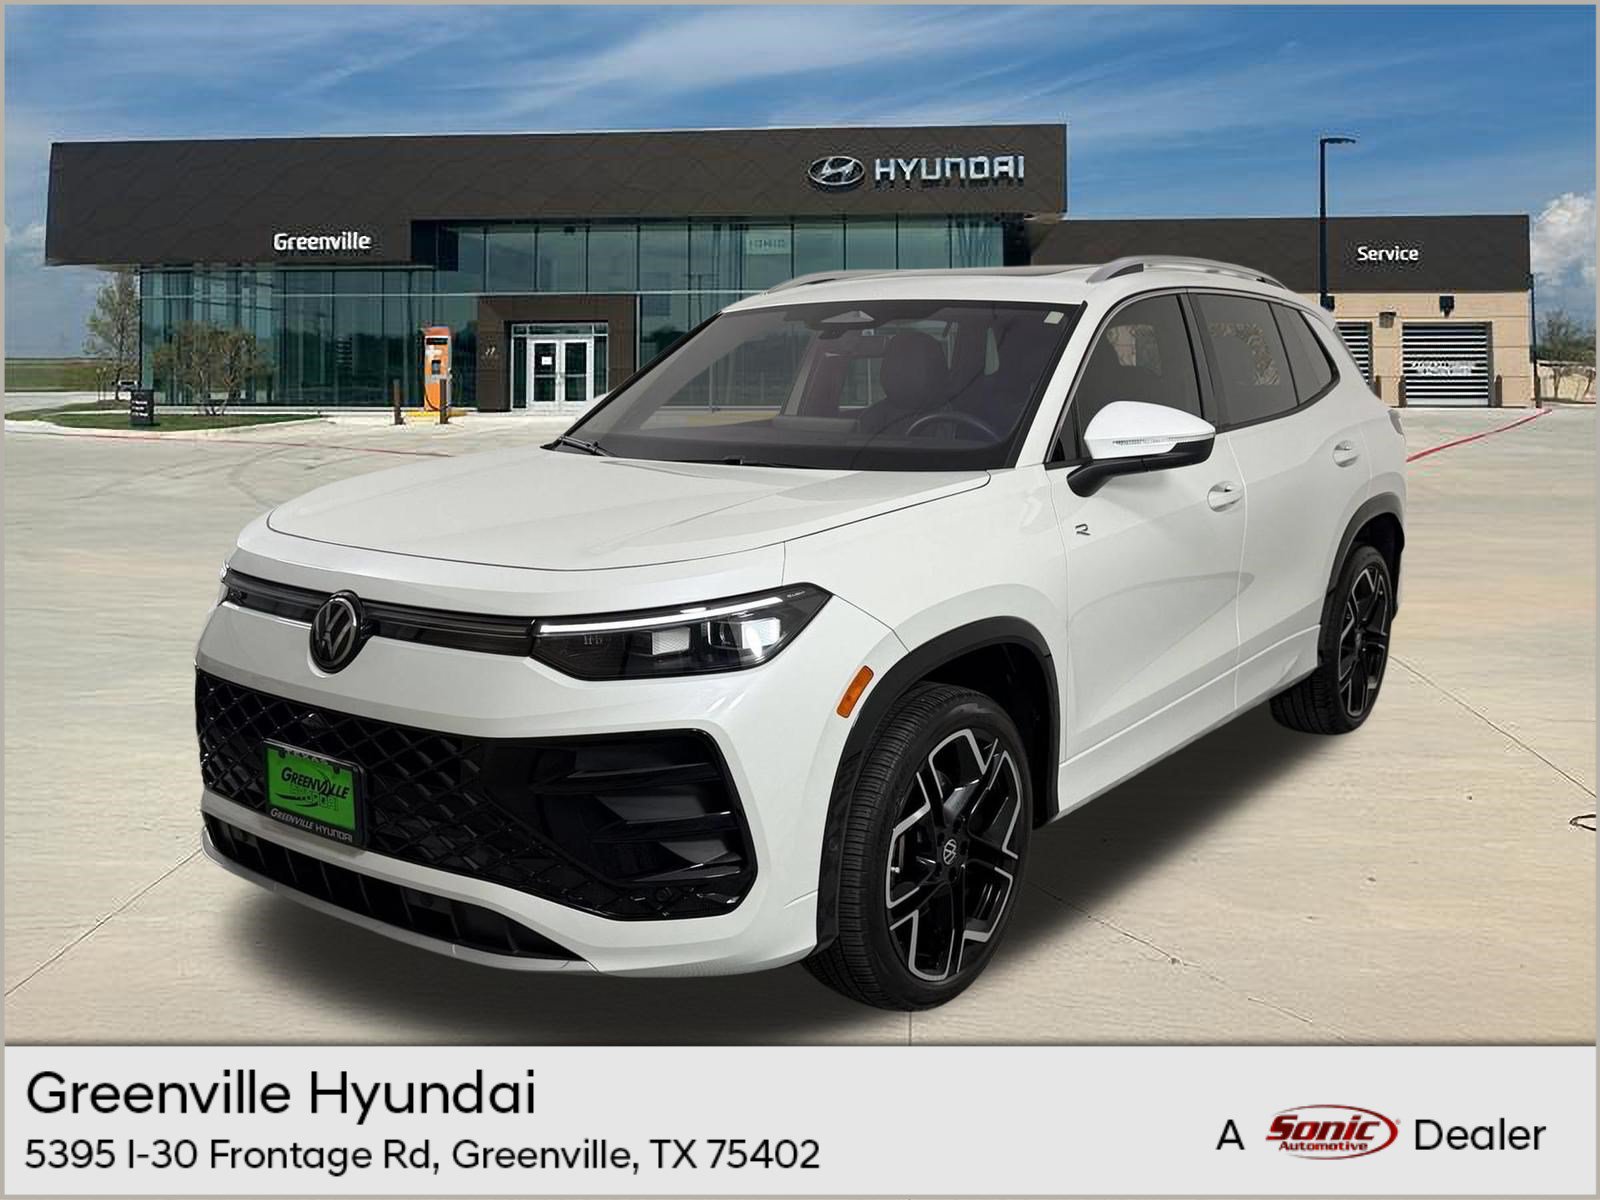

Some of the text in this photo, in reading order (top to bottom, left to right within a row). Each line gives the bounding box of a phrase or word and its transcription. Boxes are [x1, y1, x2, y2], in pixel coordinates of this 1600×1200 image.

[875, 155, 1025, 181] HYUNDAI
[273, 231, 371, 251] Greenville
[1357, 245, 1419, 261] Service
[270, 808, 353, 843] GREENVILLE HYUNDAI
